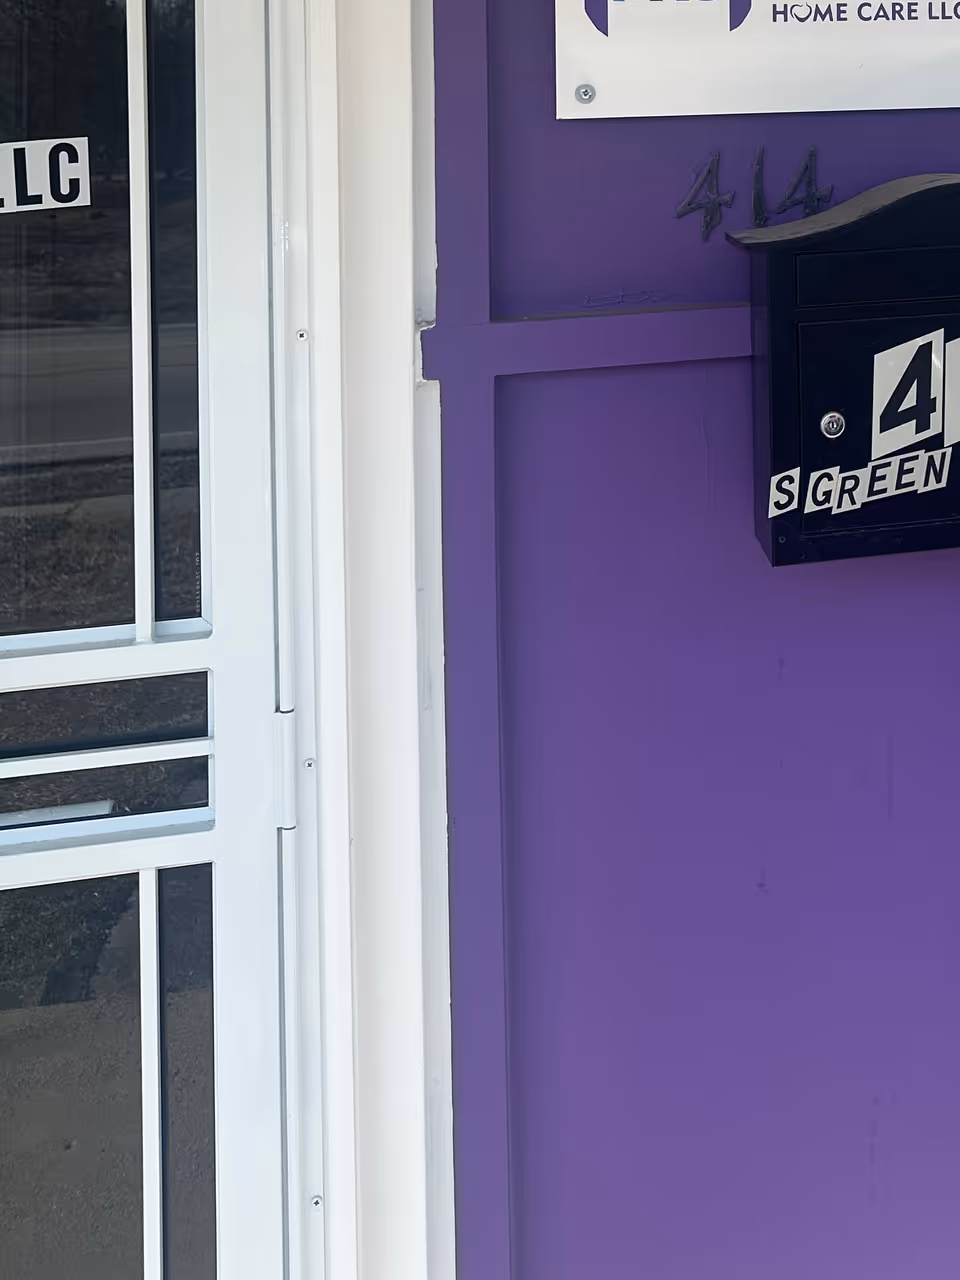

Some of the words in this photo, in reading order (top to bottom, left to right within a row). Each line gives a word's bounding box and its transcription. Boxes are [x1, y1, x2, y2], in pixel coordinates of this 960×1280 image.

[856, 1, 920, 22] CARE
[0, 142, 81, 208] LC
[675, 145, 834, 242] 414
[772, 473, 797, 511] S
[809, 449, 949, 510] GREEN
